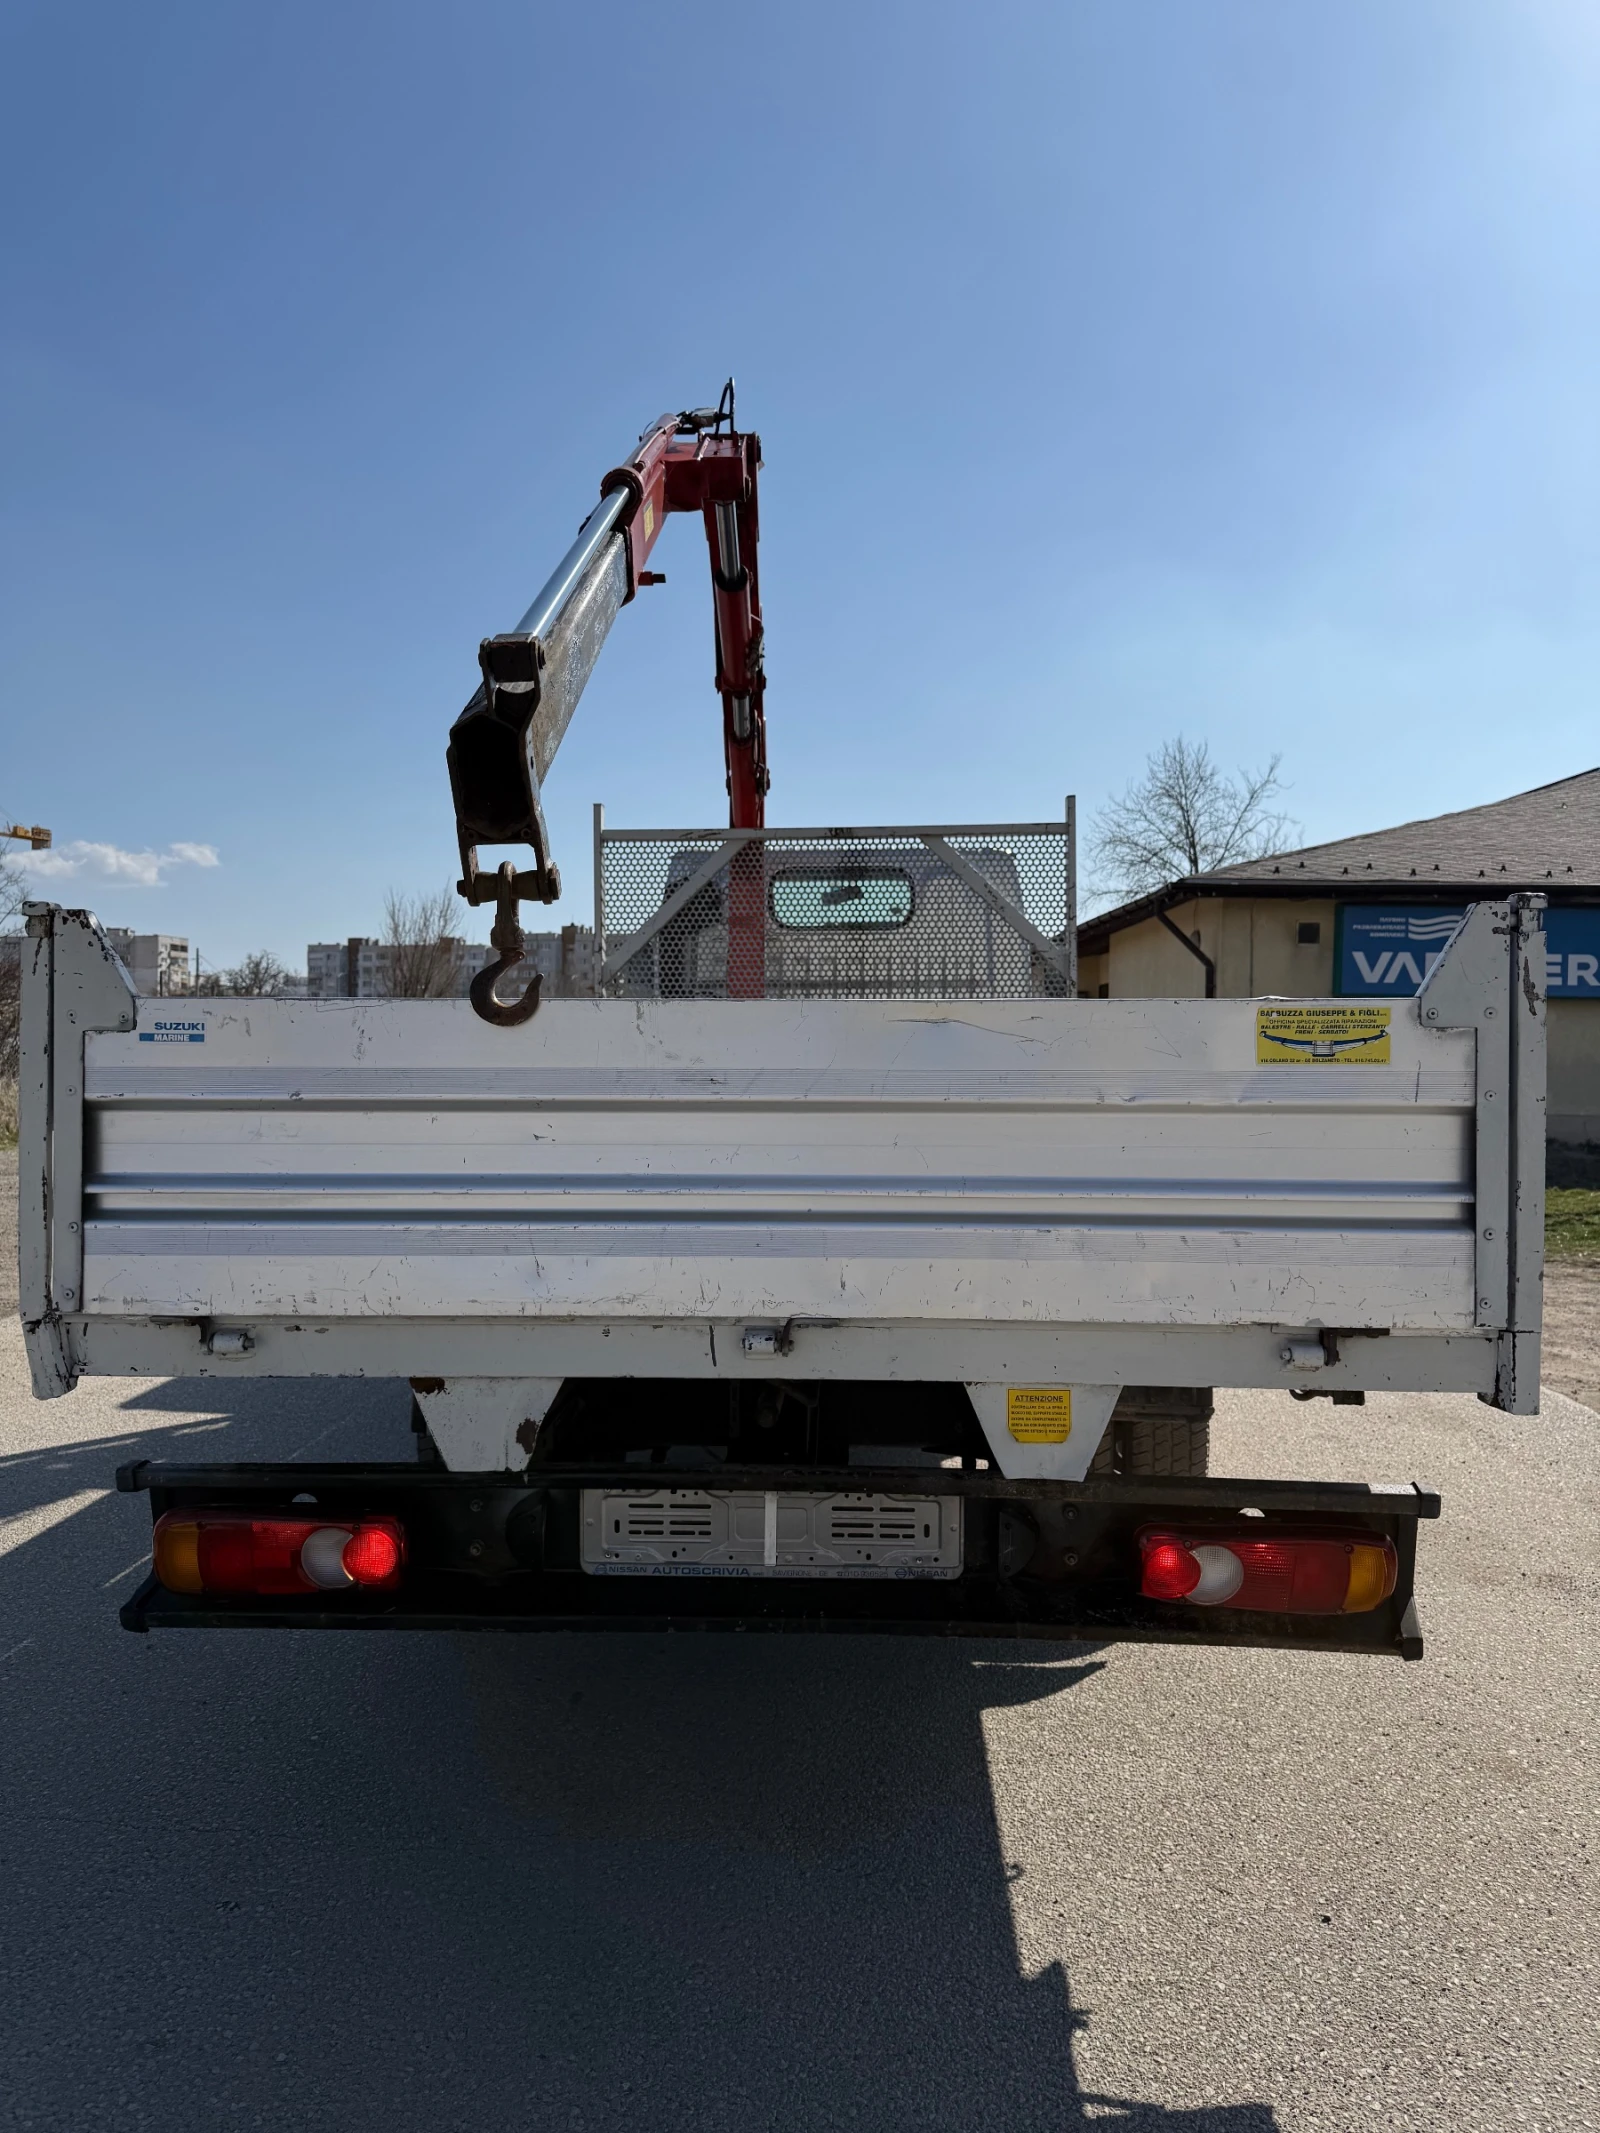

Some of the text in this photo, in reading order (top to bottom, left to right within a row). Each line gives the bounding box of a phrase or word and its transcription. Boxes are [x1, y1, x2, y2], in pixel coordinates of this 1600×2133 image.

[1306, 1009, 1347, 1017] GIUSEPPE
[1349, 1009, 1356, 1017] &
[154, 1022, 205, 1031] SUZUKI
[154, 1034, 190, 1042] MARINE
[1015, 1395, 1064, 1403] ATTENZIONE
[651, 1566, 750, 1576] AUTOSCRIVIA
[907, 1569, 948, 1577] NISSAN
